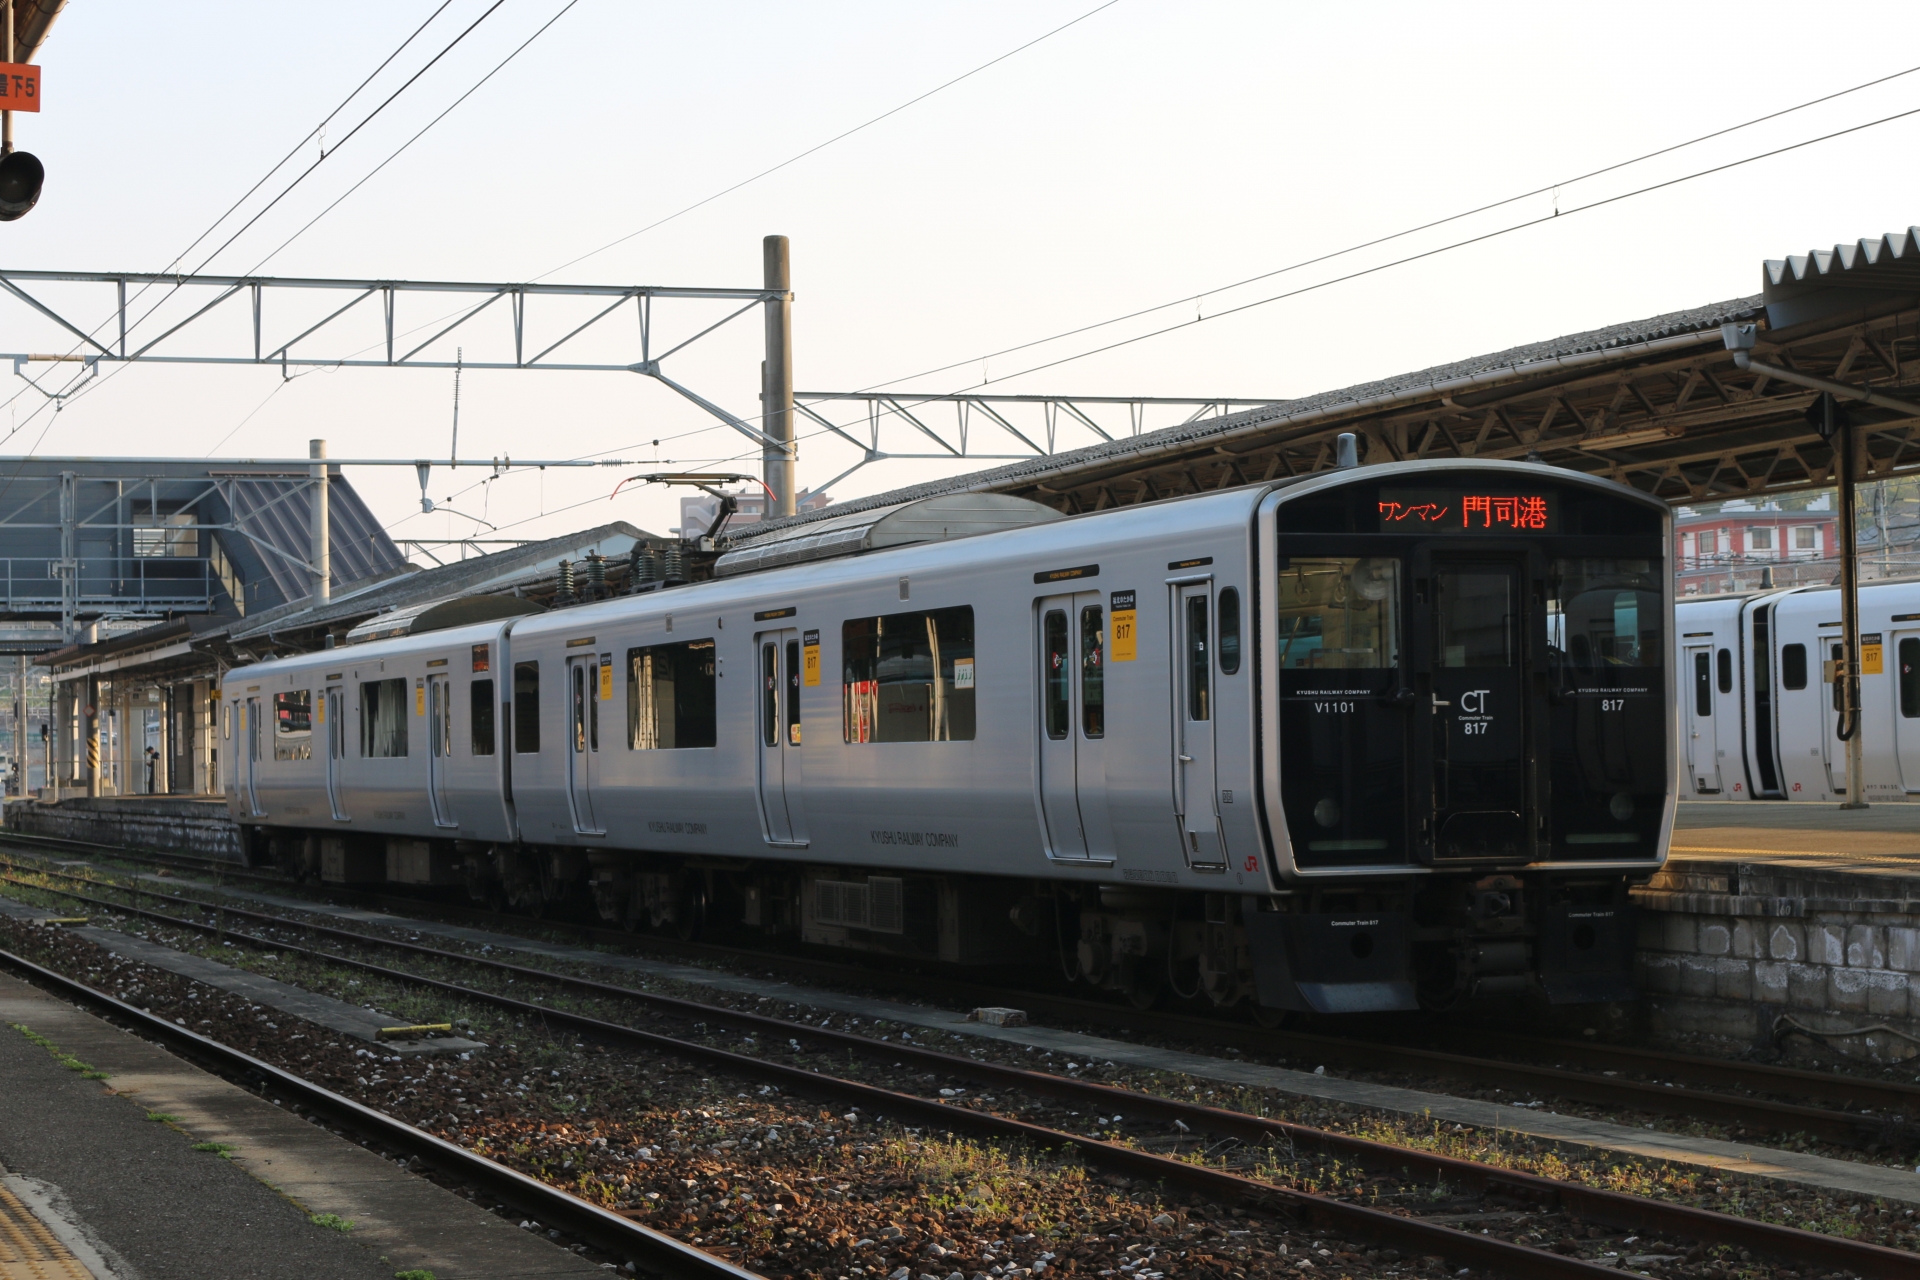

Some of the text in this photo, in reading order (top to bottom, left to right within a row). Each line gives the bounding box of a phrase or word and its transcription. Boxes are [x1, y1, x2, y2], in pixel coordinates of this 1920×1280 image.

[1378, 495, 1547, 529] ワンマン 門司港
[1116, 624, 1131, 639] 817
[807, 656, 817, 669] 817
[1865, 653, 1878, 662] 817
[1314, 702, 1354, 713] V1101
[1461, 690, 1490, 713] CT
[1602, 700, 1625, 711] 817
[1464, 722, 1488, 734] 817
[1733, 783, 1743, 792] JR
[1792, 783, 1802, 792] JR
[870, 830, 959, 848] KYUSHU RAILWAY COMPANY
[1244, 856, 1260, 872] JR
